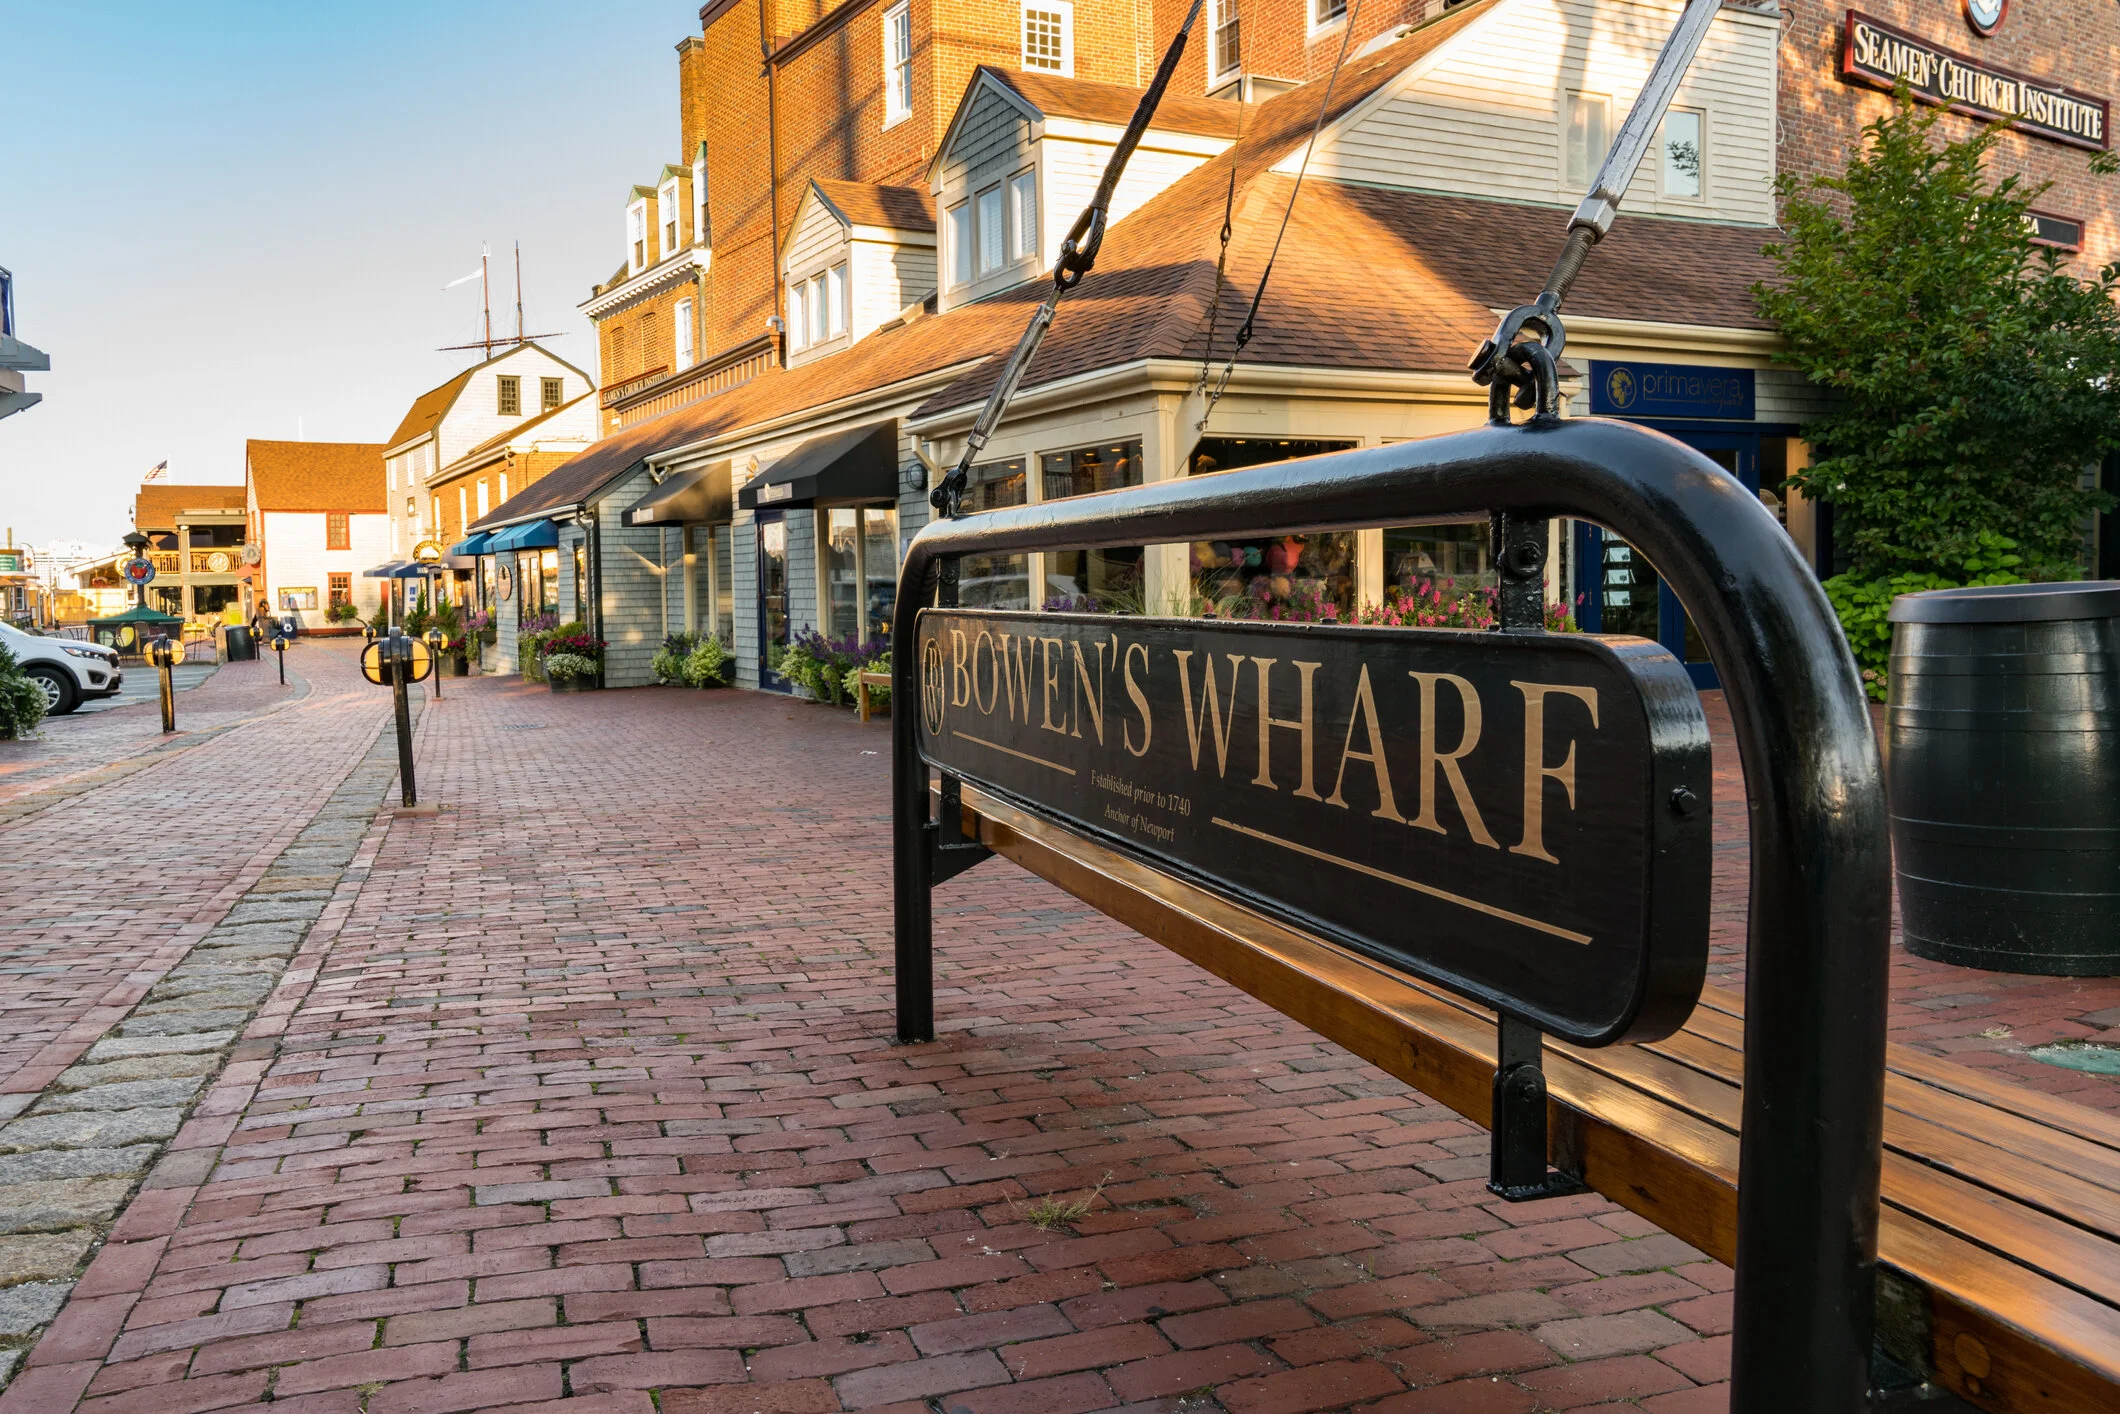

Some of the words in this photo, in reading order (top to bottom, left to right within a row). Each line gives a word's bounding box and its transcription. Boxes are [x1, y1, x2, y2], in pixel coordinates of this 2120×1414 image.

[1938, 57, 2016, 114] CHURCH
[2018, 81, 2103, 140] INSTITUTE
[1643, 370, 1741, 400] primavera
[950, 629, 1152, 758] BOWEN'S
[1173, 649, 1600, 865] WHARF
[1134, 785, 1155, 805] prior
[1157, 792, 1166, 808] to
[1168, 794, 1191, 817] 1740
[1104, 804, 1130, 825] Anchor
[1131, 813, 1140, 833] of
[1140, 815, 1175, 842] Newport
